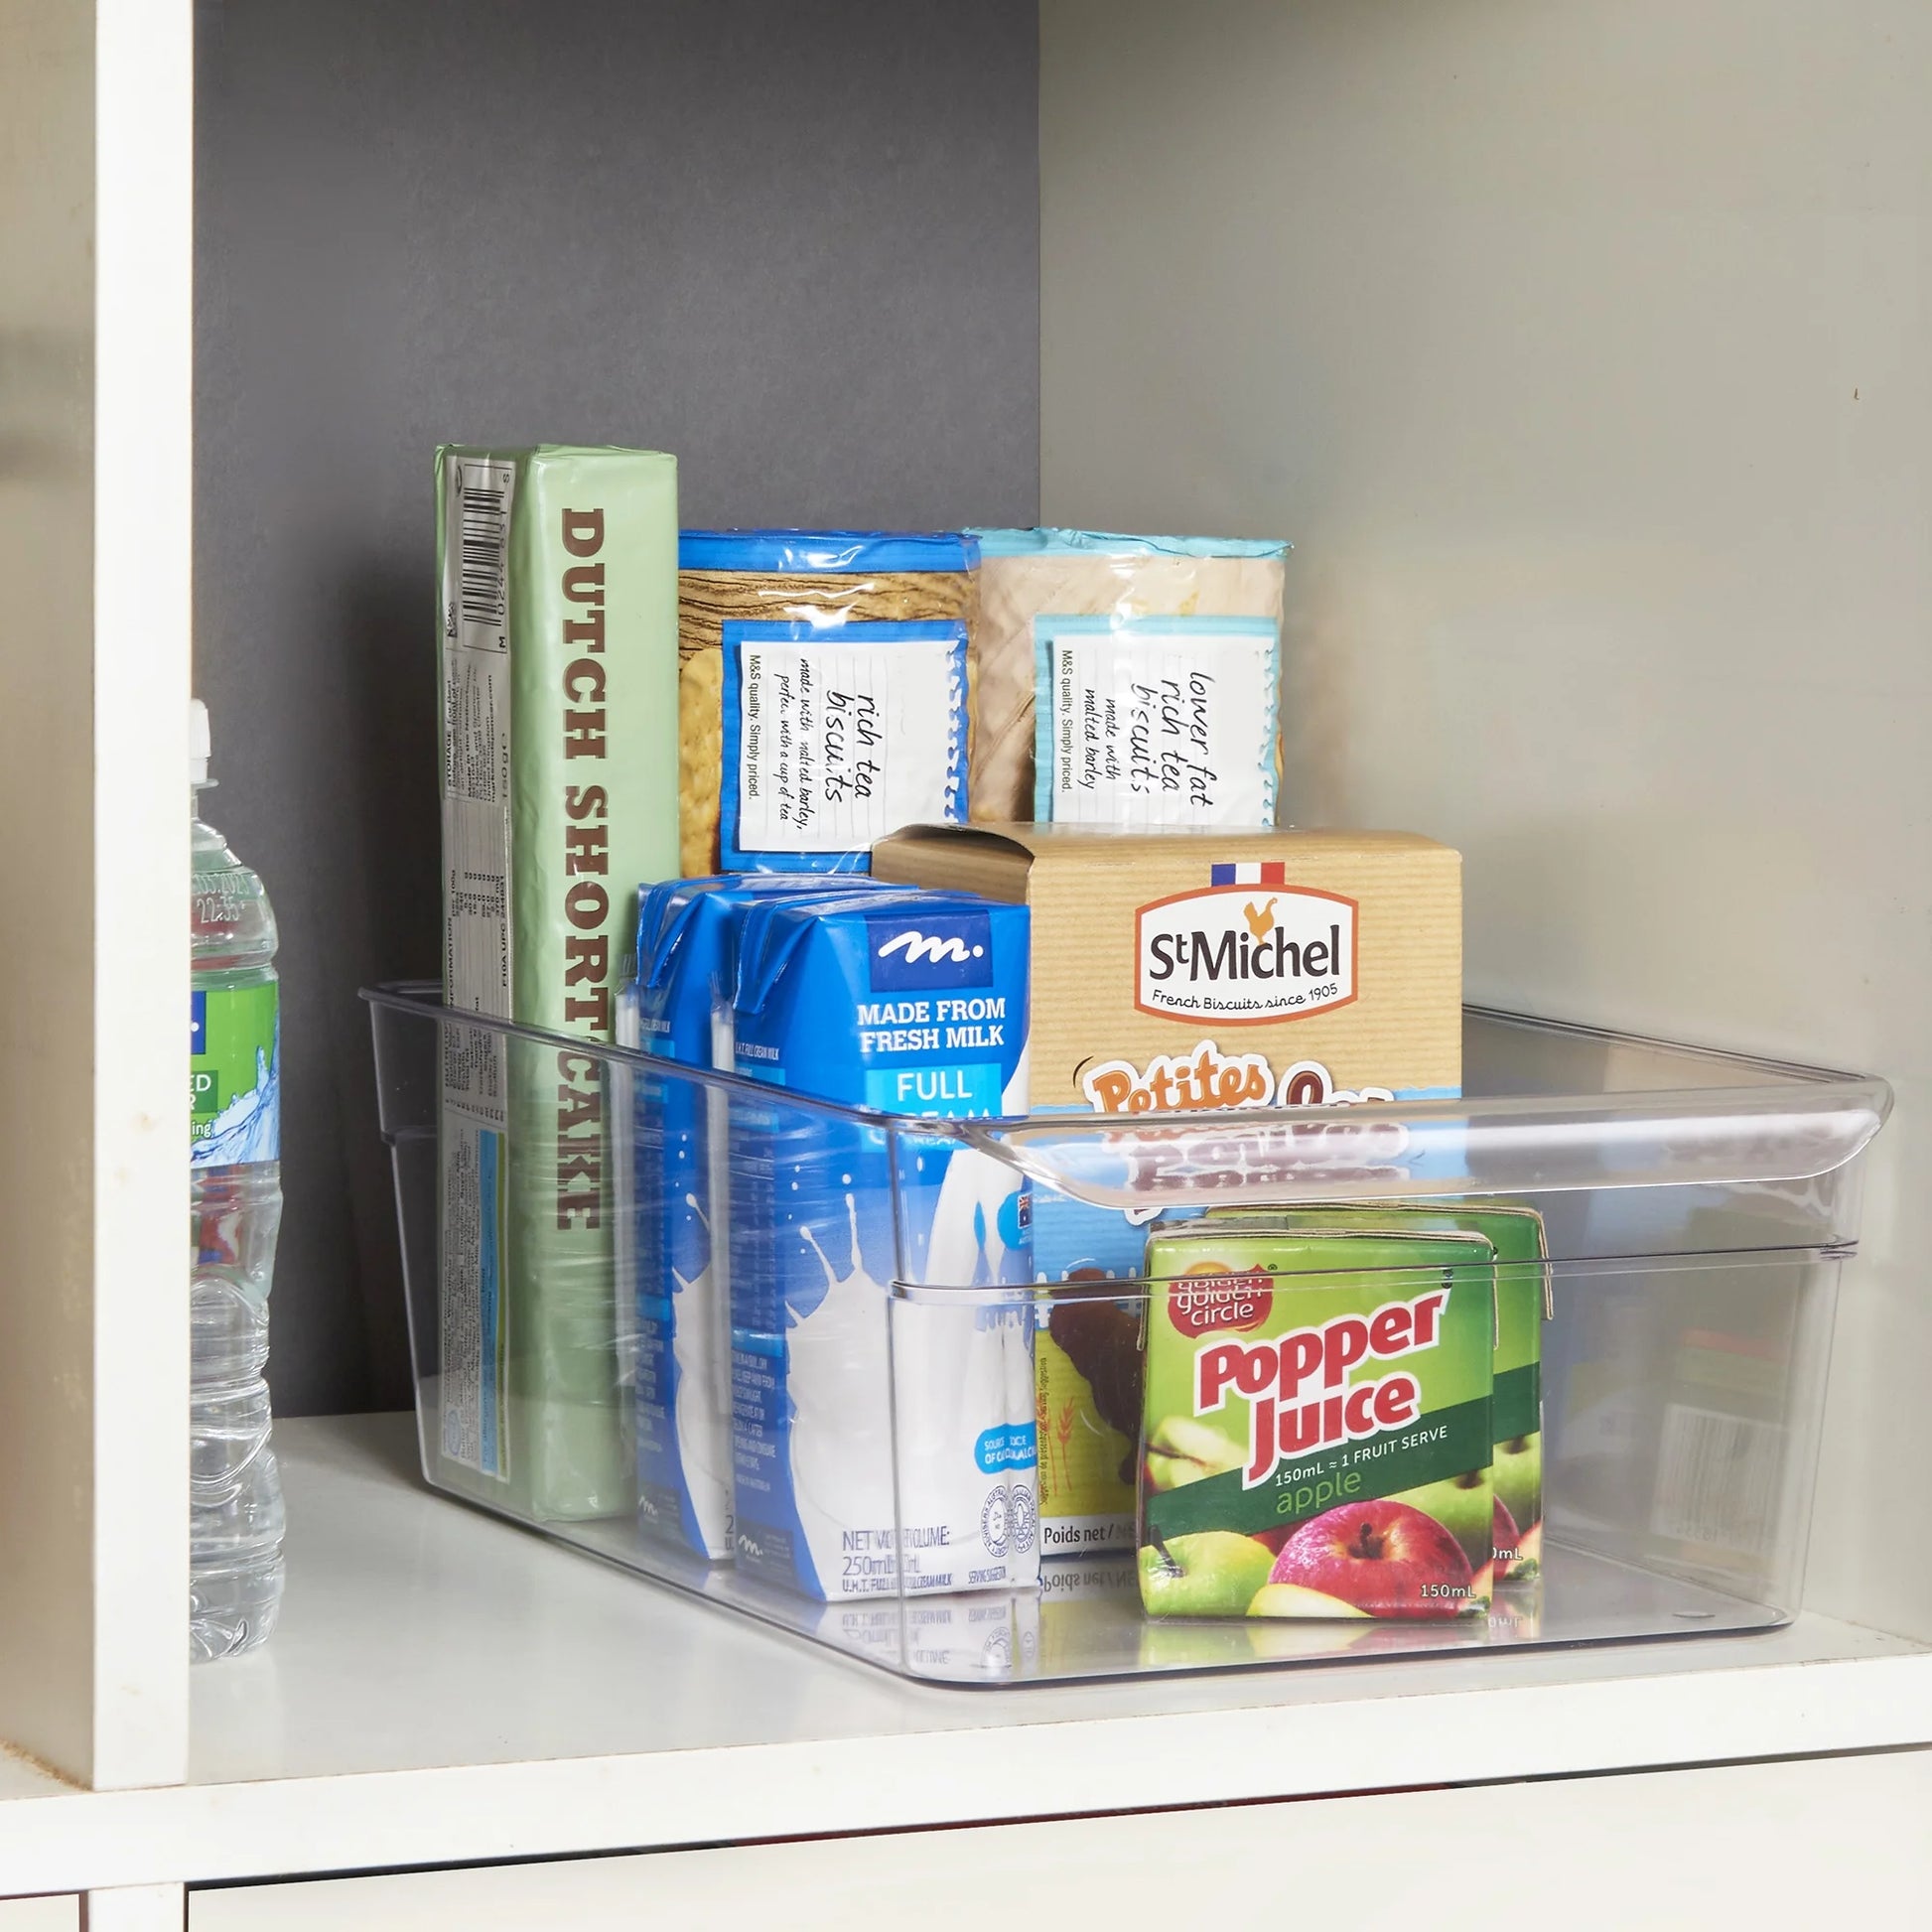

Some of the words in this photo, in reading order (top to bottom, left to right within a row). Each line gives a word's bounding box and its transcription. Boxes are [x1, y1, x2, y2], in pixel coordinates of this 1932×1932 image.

[561, 507, 608, 760] DUTCH
[749, 654, 762, 680] M&S
[798, 657, 816, 694] made
[1061, 649, 1074, 675] M&S
[745, 683, 762, 722] quality.
[797, 699, 815, 731] with
[1059, 677, 1074, 716] quality.
[1161, 679, 1190, 736] rich
[1189, 672, 1217, 756] lower
[779, 720, 793, 748] with
[856, 695, 883, 746] rich
[1084, 688, 1104, 743] malted
[1105, 698, 1121, 738] made
[747, 724, 762, 761] Simply
[824, 690, 856, 803] biscuits
[1060, 719, 1074, 755] Simply
[1131, 683, 1160, 794] biscuits
[747, 763, 762, 800] priced.
[772, 762, 789, 784] cup
[854, 759, 882, 798] tea
[1058, 757, 1073, 793] priced.
[1077, 746, 1104, 790] barley
[1106, 745, 1122, 781] with
[1161, 750, 1189, 792] tea
[778, 786, 795, 799] of
[1186, 764, 1218, 807] fat
[779, 803, 793, 821] tea
[791, 787, 816, 831] barley,
[857, 1002, 930, 1027] MADE
[935, 997, 1007, 1023] FROM
[1152, 989, 1201, 1011] French
[1203, 996, 1263, 1011] Biscuits
[1265, 993, 1306, 1010] since
[1309, 982, 1338, 1002] 1905
[860, 1028, 941, 1053] FRESH
[945, 1025, 1006, 1048] MILK
[897, 1069, 973, 1102] FULL
[1091, 1049, 1267, 1114] Petites
[1190, 1302, 1255, 1326] circle
[1199, 1294, 1445, 1410] Popper
[1243, 1375, 1418, 1482] Juice
[1275, 1463, 1325, 1487] 150mL
[1341, 1452, 1349, 1468] 1
[1353, 1442, 1397, 1465] FRUIT
[1401, 1426, 1449, 1451] SERVE
[1275, 1469, 1362, 1516] apple
[842, 1530, 872, 1551] NET
[1043, 1525, 1081, 1544] Poids
[1083, 1527, 1106, 1542] net
[1420, 1583, 1476, 1599] 150mL
